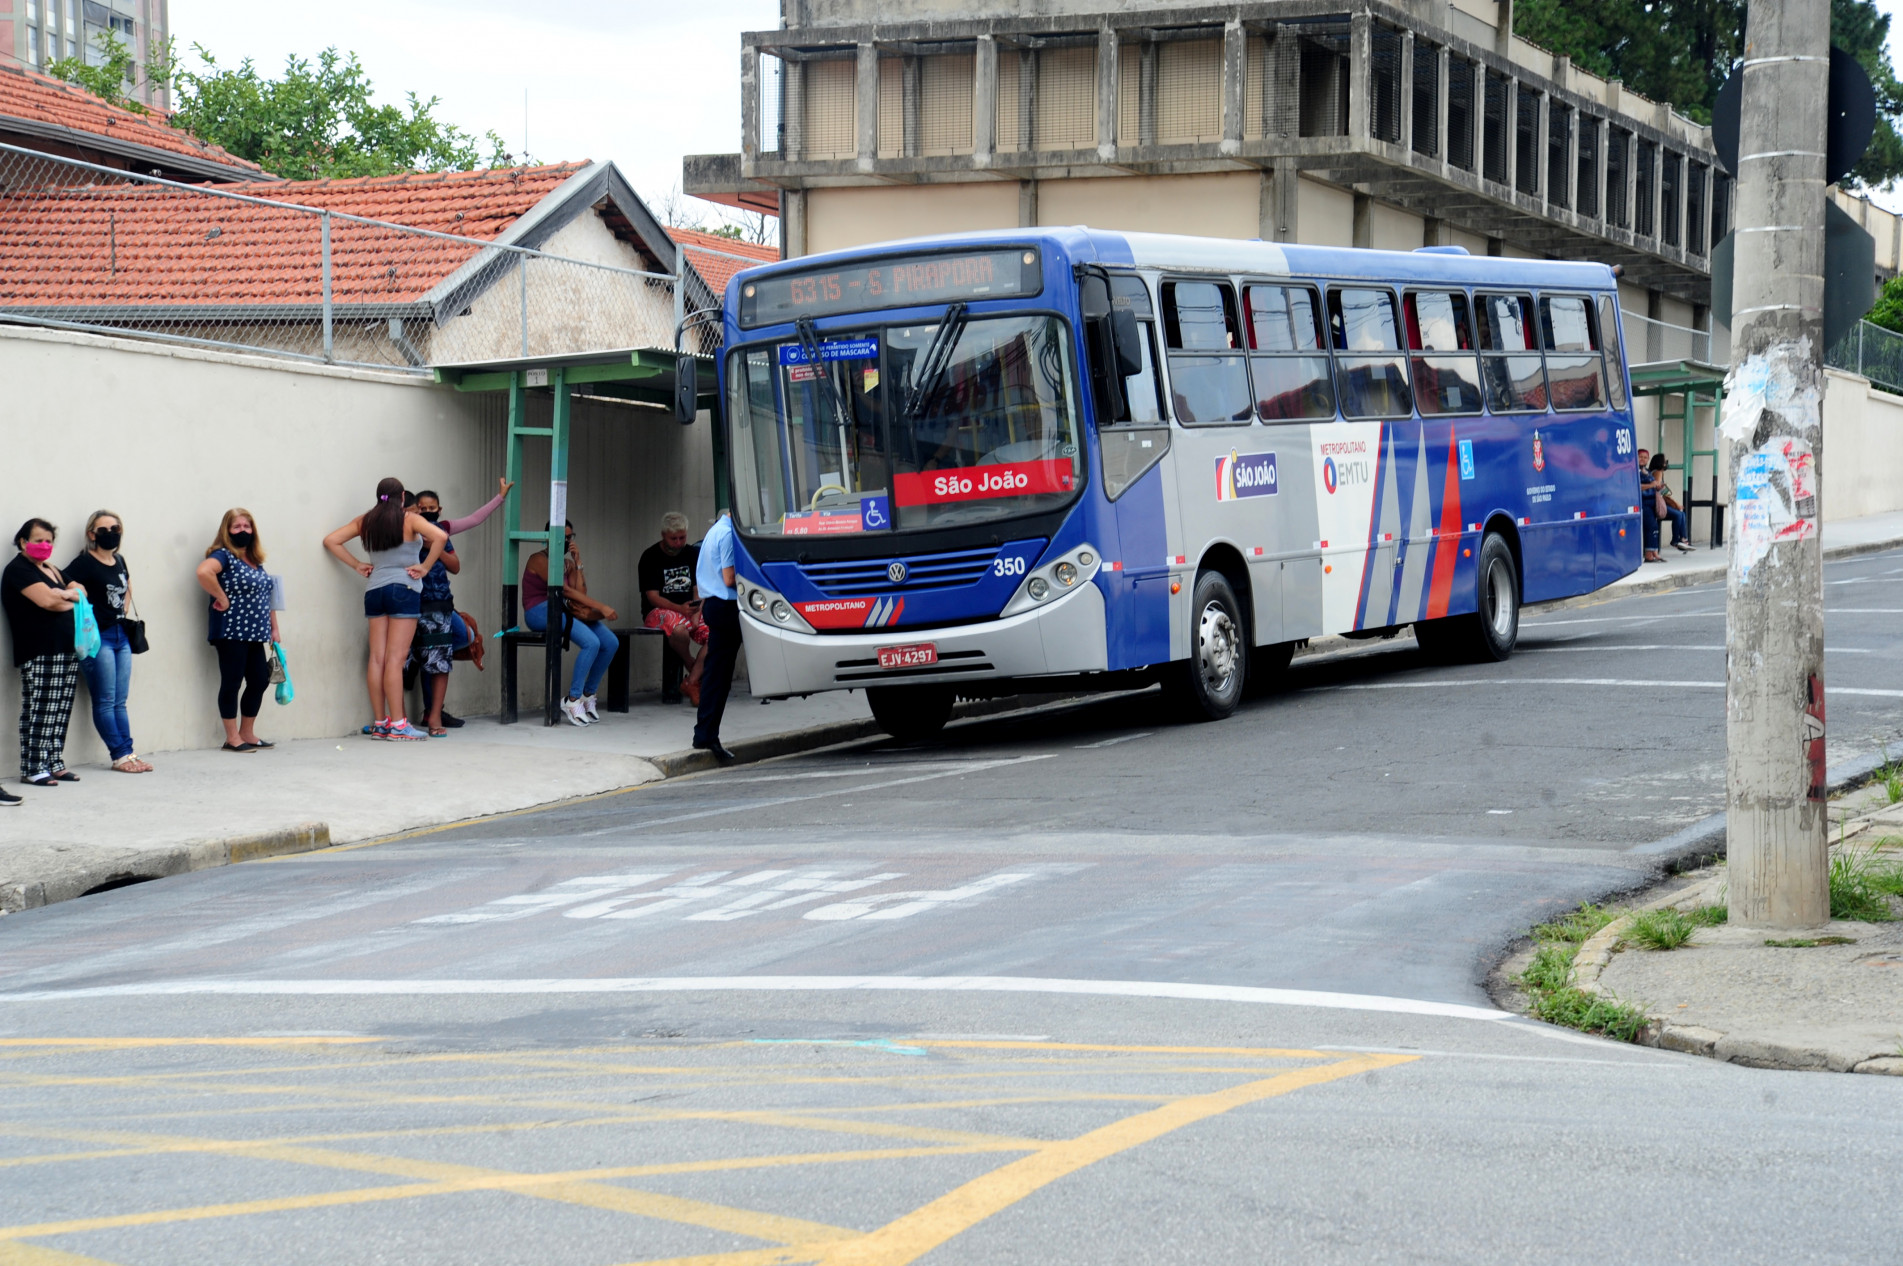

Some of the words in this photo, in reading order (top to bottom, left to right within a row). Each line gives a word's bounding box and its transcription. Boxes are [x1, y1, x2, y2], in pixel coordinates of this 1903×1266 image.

[790, 274, 841, 305] 6315
[868, 269, 883, 296] S
[892, 256, 994, 294] PIRAPORA
[826, 342, 849, 351] PERMITIDO
[850, 341, 870, 349] SOMENTE
[831, 349, 839, 358] DE
[840, 346, 870, 357] MÁSCARA
[1320, 441, 1366, 456] METROPOLITANO
[1616, 428, 1632, 455] 350
[934, 476, 973, 496] São
[978, 470, 1029, 491] João
[1236, 463, 1253, 488] SÃO
[1254, 461, 1276, 487] JOÃO
[1338, 461, 1369, 486] EMTU
[993, 556, 1025, 577] 350
[805, 601, 866, 613] METROPOLITANO
